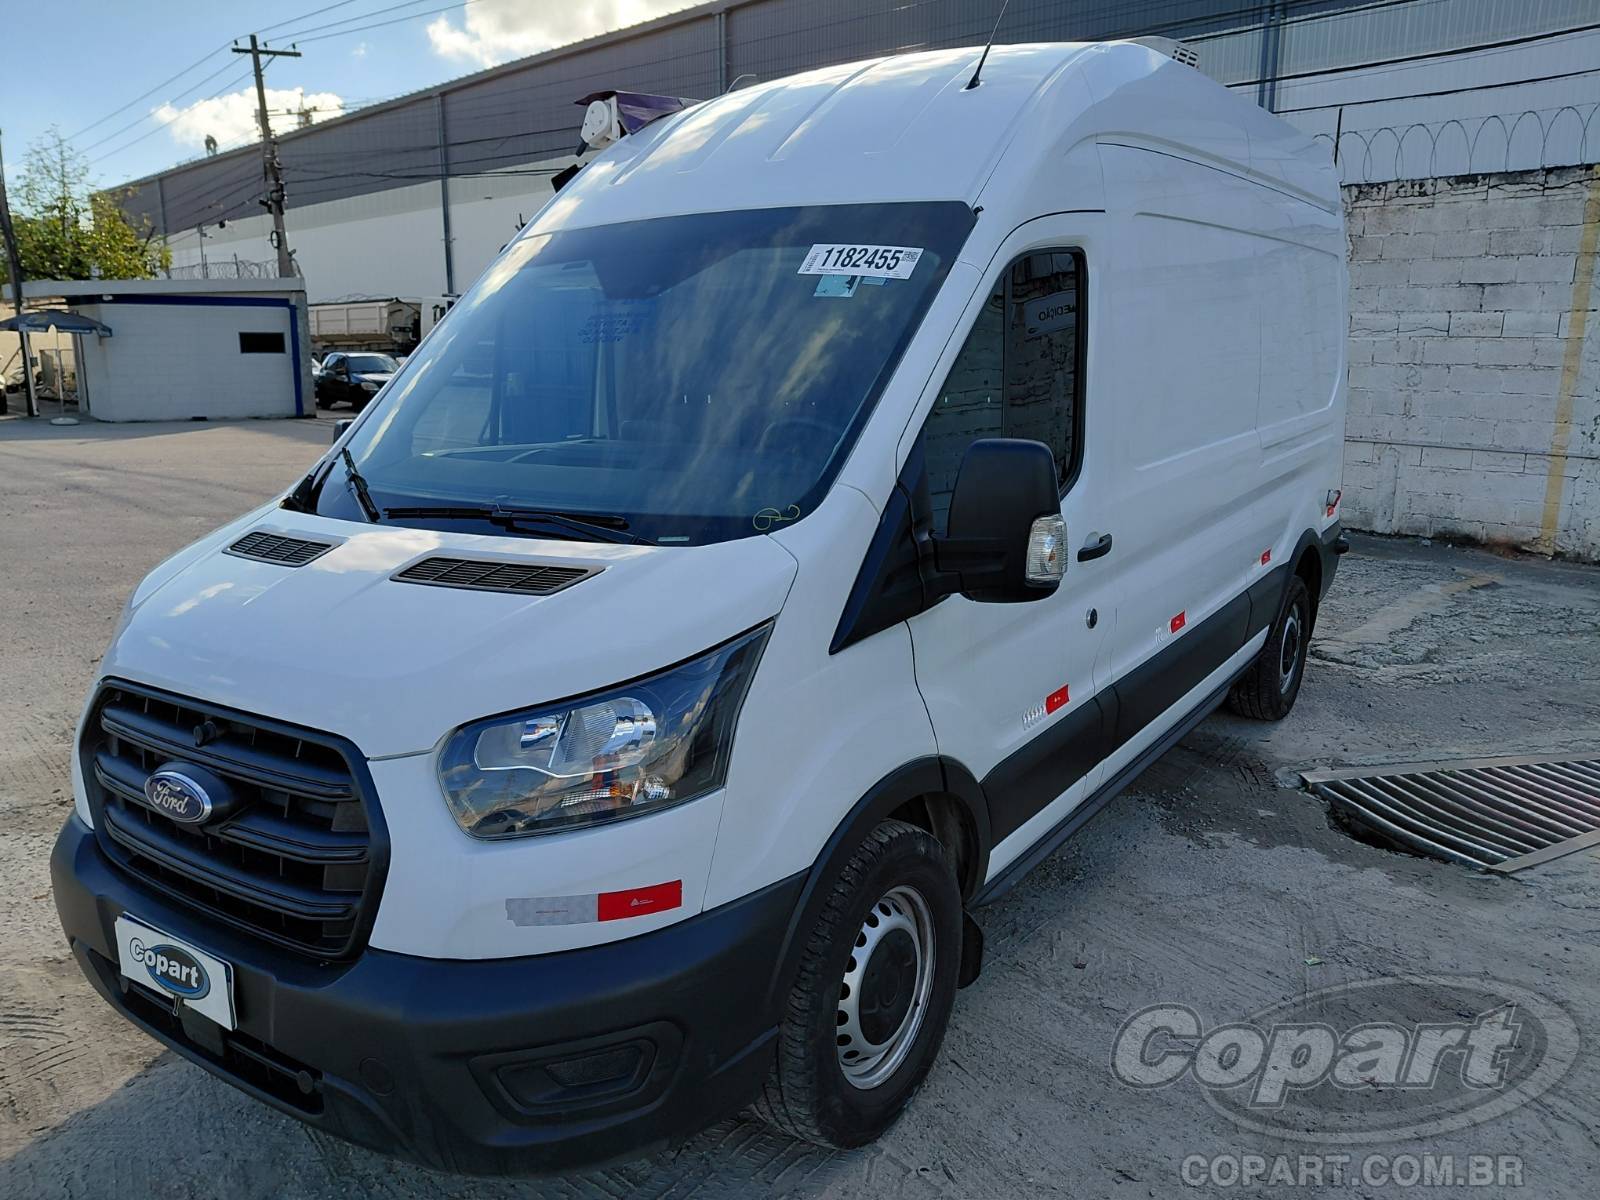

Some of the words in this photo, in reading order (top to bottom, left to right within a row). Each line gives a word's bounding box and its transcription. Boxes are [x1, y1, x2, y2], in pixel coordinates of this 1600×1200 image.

[821, 247, 903, 271] 1182455
[152, 779, 189, 815] Ford
[129, 936, 200, 989] Copart
